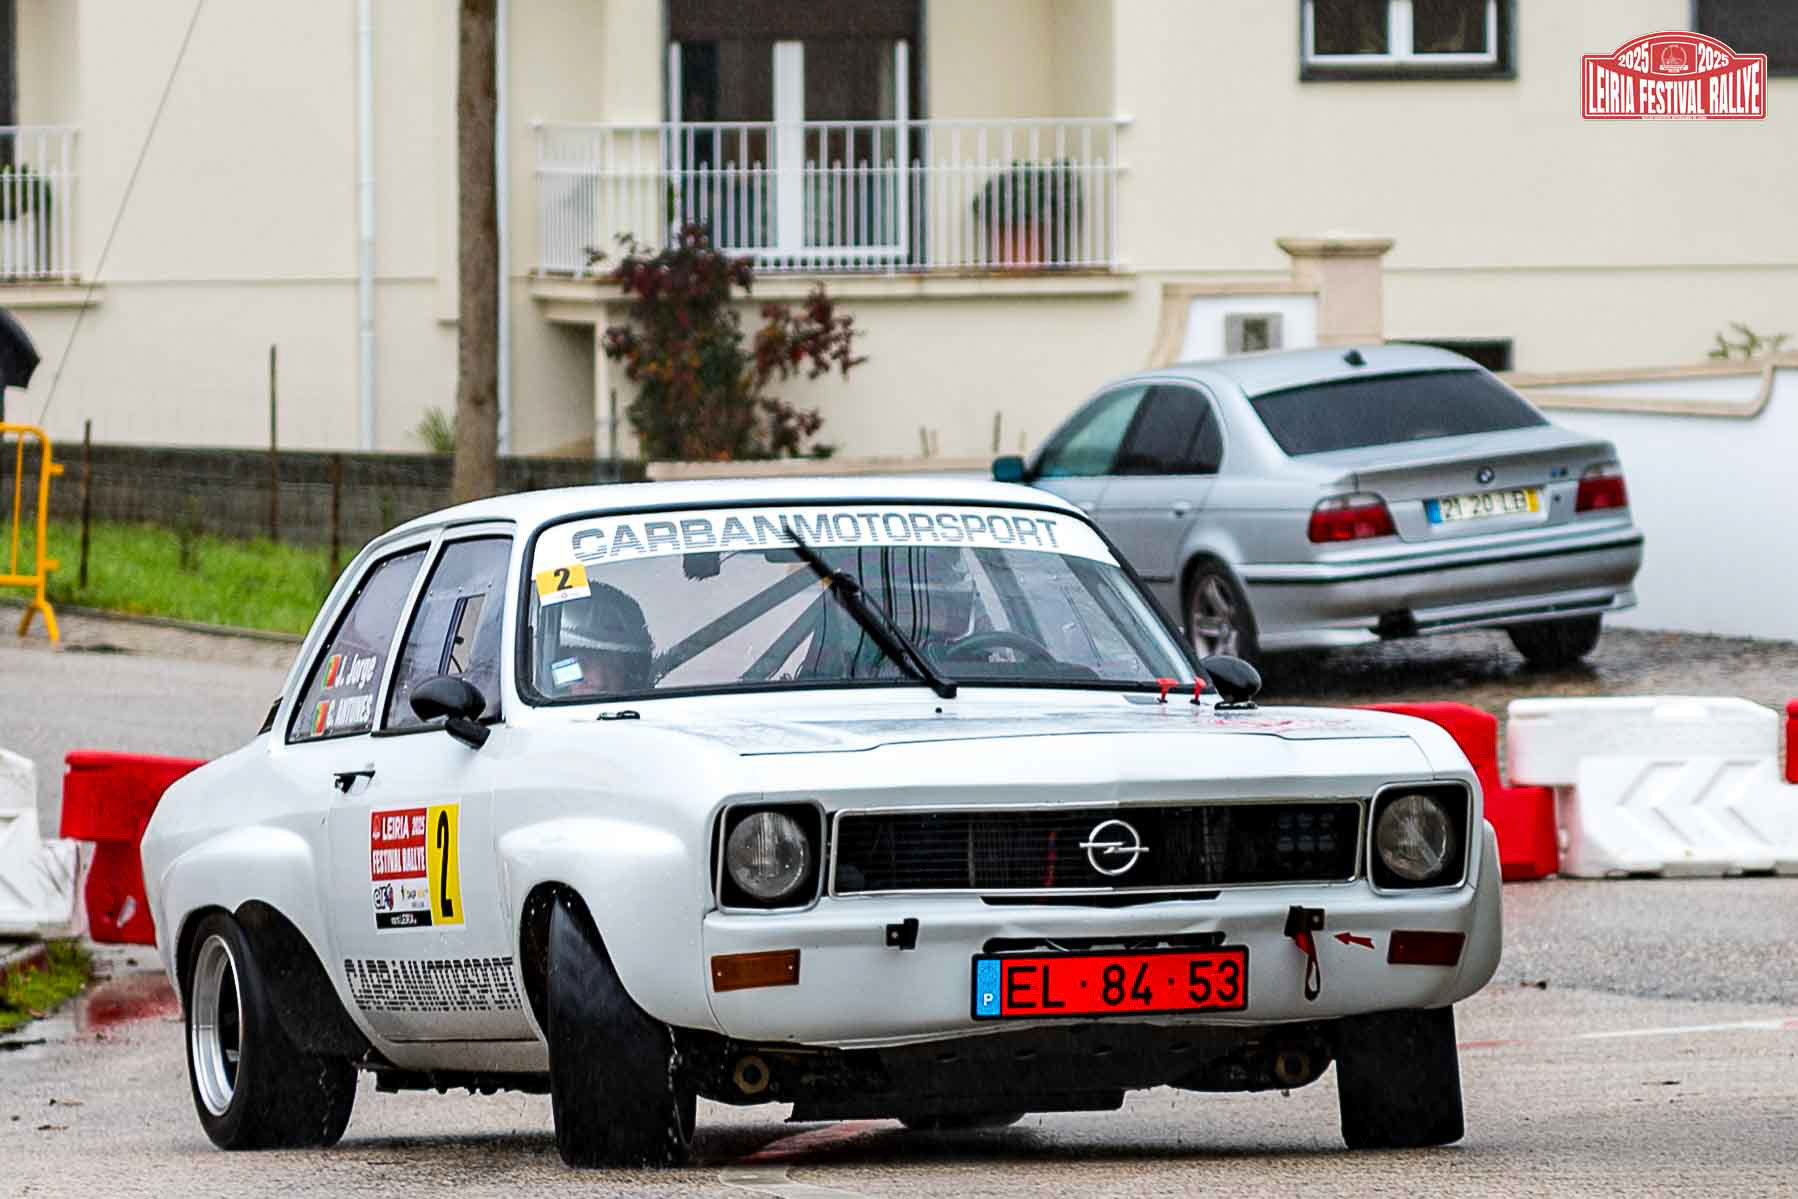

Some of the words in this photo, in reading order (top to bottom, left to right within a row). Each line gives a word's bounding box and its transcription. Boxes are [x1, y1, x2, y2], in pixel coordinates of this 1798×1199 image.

[552, 568, 573, 591] 2
[346, 653, 377, 690] Jorge
[382, 815, 409, 840] LEIRIA
[372, 848, 402, 874] FESTIVAL
[402, 846, 426, 872] RALLYE
[436, 810, 454, 917] 2
[1007, 966, 1064, 1009] EL
[1102, 963, 1153, 1006] 84
[1188, 960, 1239, 1003] 53
[983, 993, 993, 1006] P
